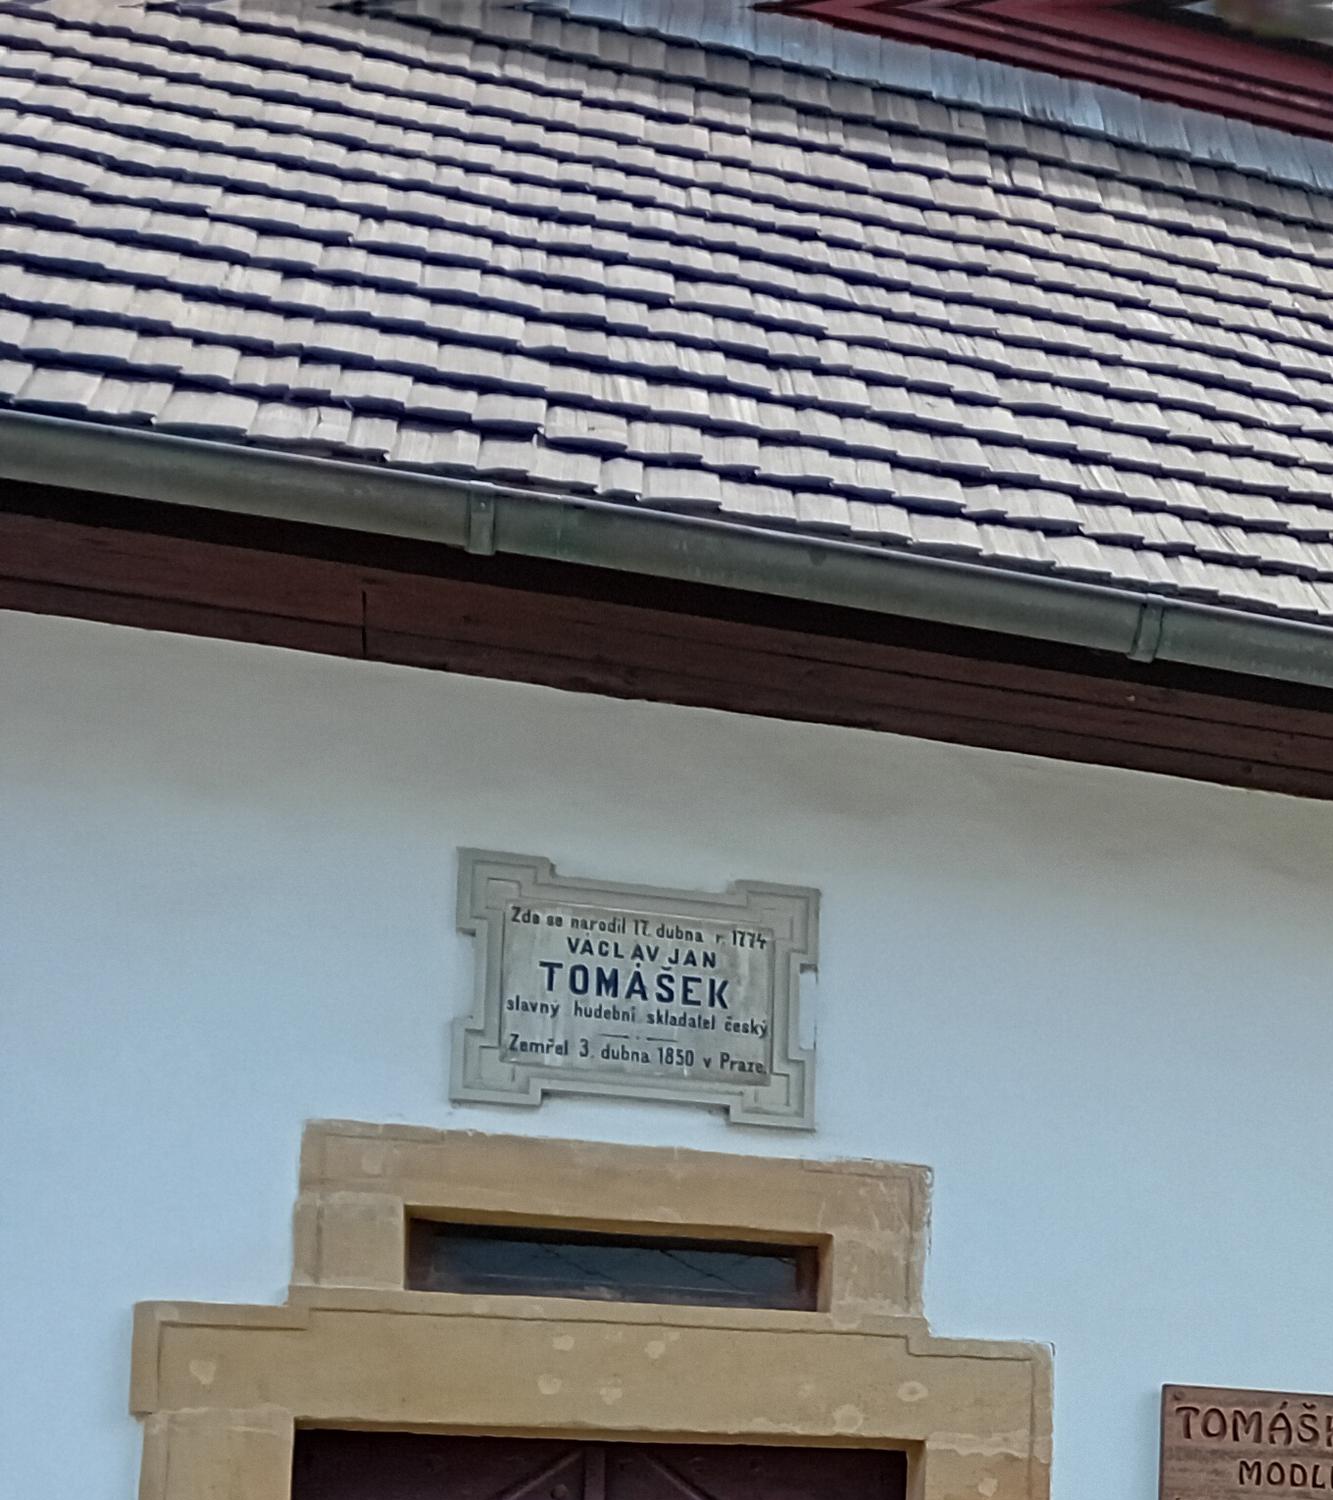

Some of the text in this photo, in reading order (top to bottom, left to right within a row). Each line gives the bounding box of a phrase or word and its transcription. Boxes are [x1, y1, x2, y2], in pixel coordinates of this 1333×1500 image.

[511, 905, 540, 924] Zde
[546, 915, 563, 927] se
[570, 917, 626, 934] narodil
[656, 923, 704, 942] dubna
[732, 929, 767, 949] 1774
[567, 932, 716, 968] VÁCLAV JAN
[538, 960, 729, 1009] TOMÁŠEK
[506, 995, 560, 1018] slavný
[646, 1008, 716, 1030] skladatel
[724, 1015, 768, 1039] český
[509, 1033, 568, 1056] Zemřel
[601, 1043, 650, 1064] dubna
[657, 1046, 695, 1067] 1850
[703, 1057, 712, 1068] v
[720, 1051, 767, 1074] Praze.
